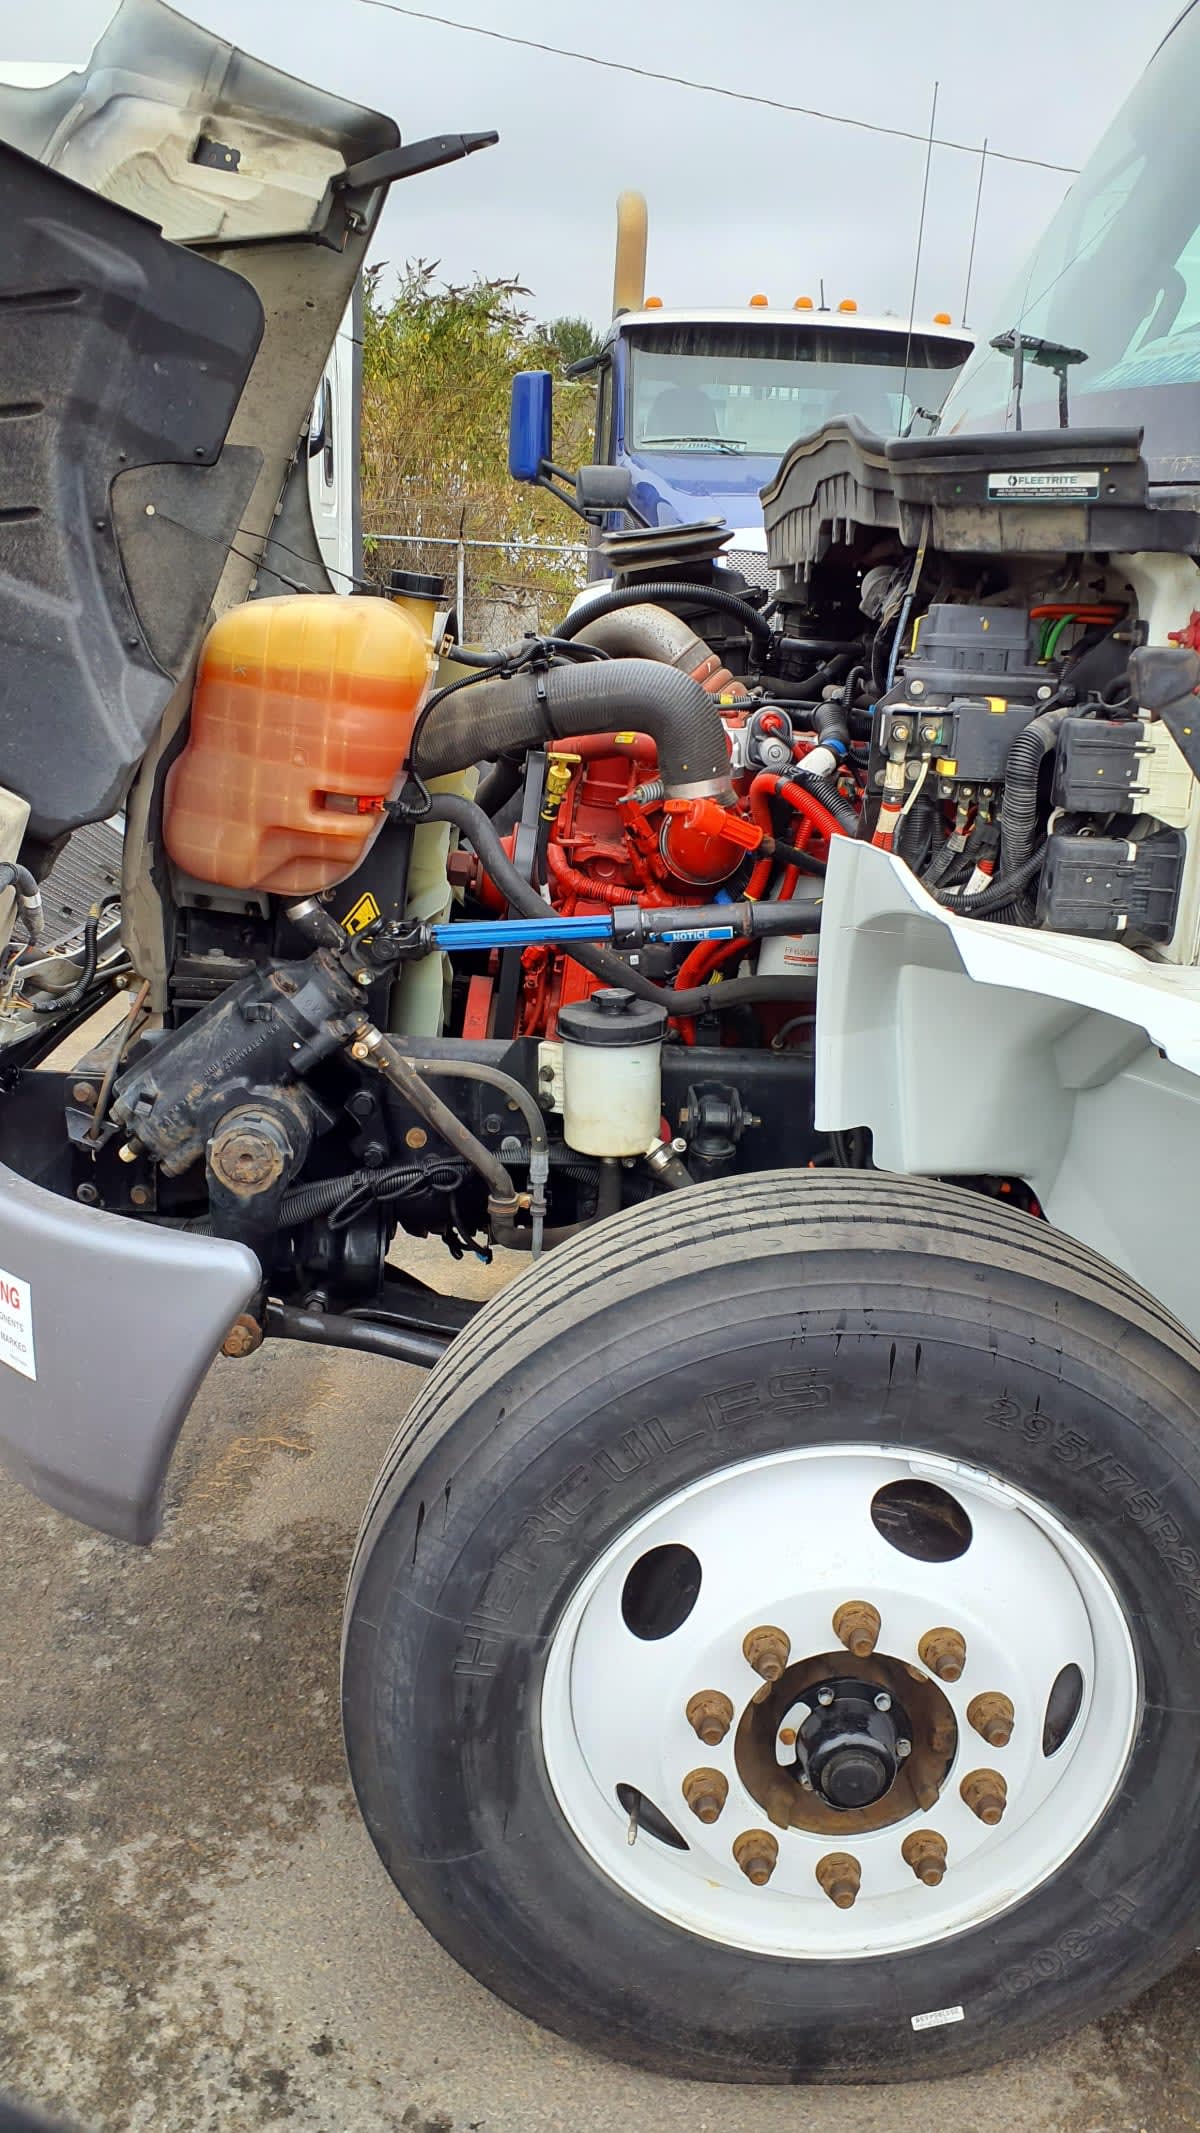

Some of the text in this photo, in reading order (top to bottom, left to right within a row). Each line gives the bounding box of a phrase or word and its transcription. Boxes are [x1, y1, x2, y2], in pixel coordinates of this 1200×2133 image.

[1018, 475, 1078, 485] FLEETRITE
[672, 931, 710, 941] NOTICE
[0, 1331, 27, 1353] MARKED
[454, 1367, 832, 1678] HERCULES
